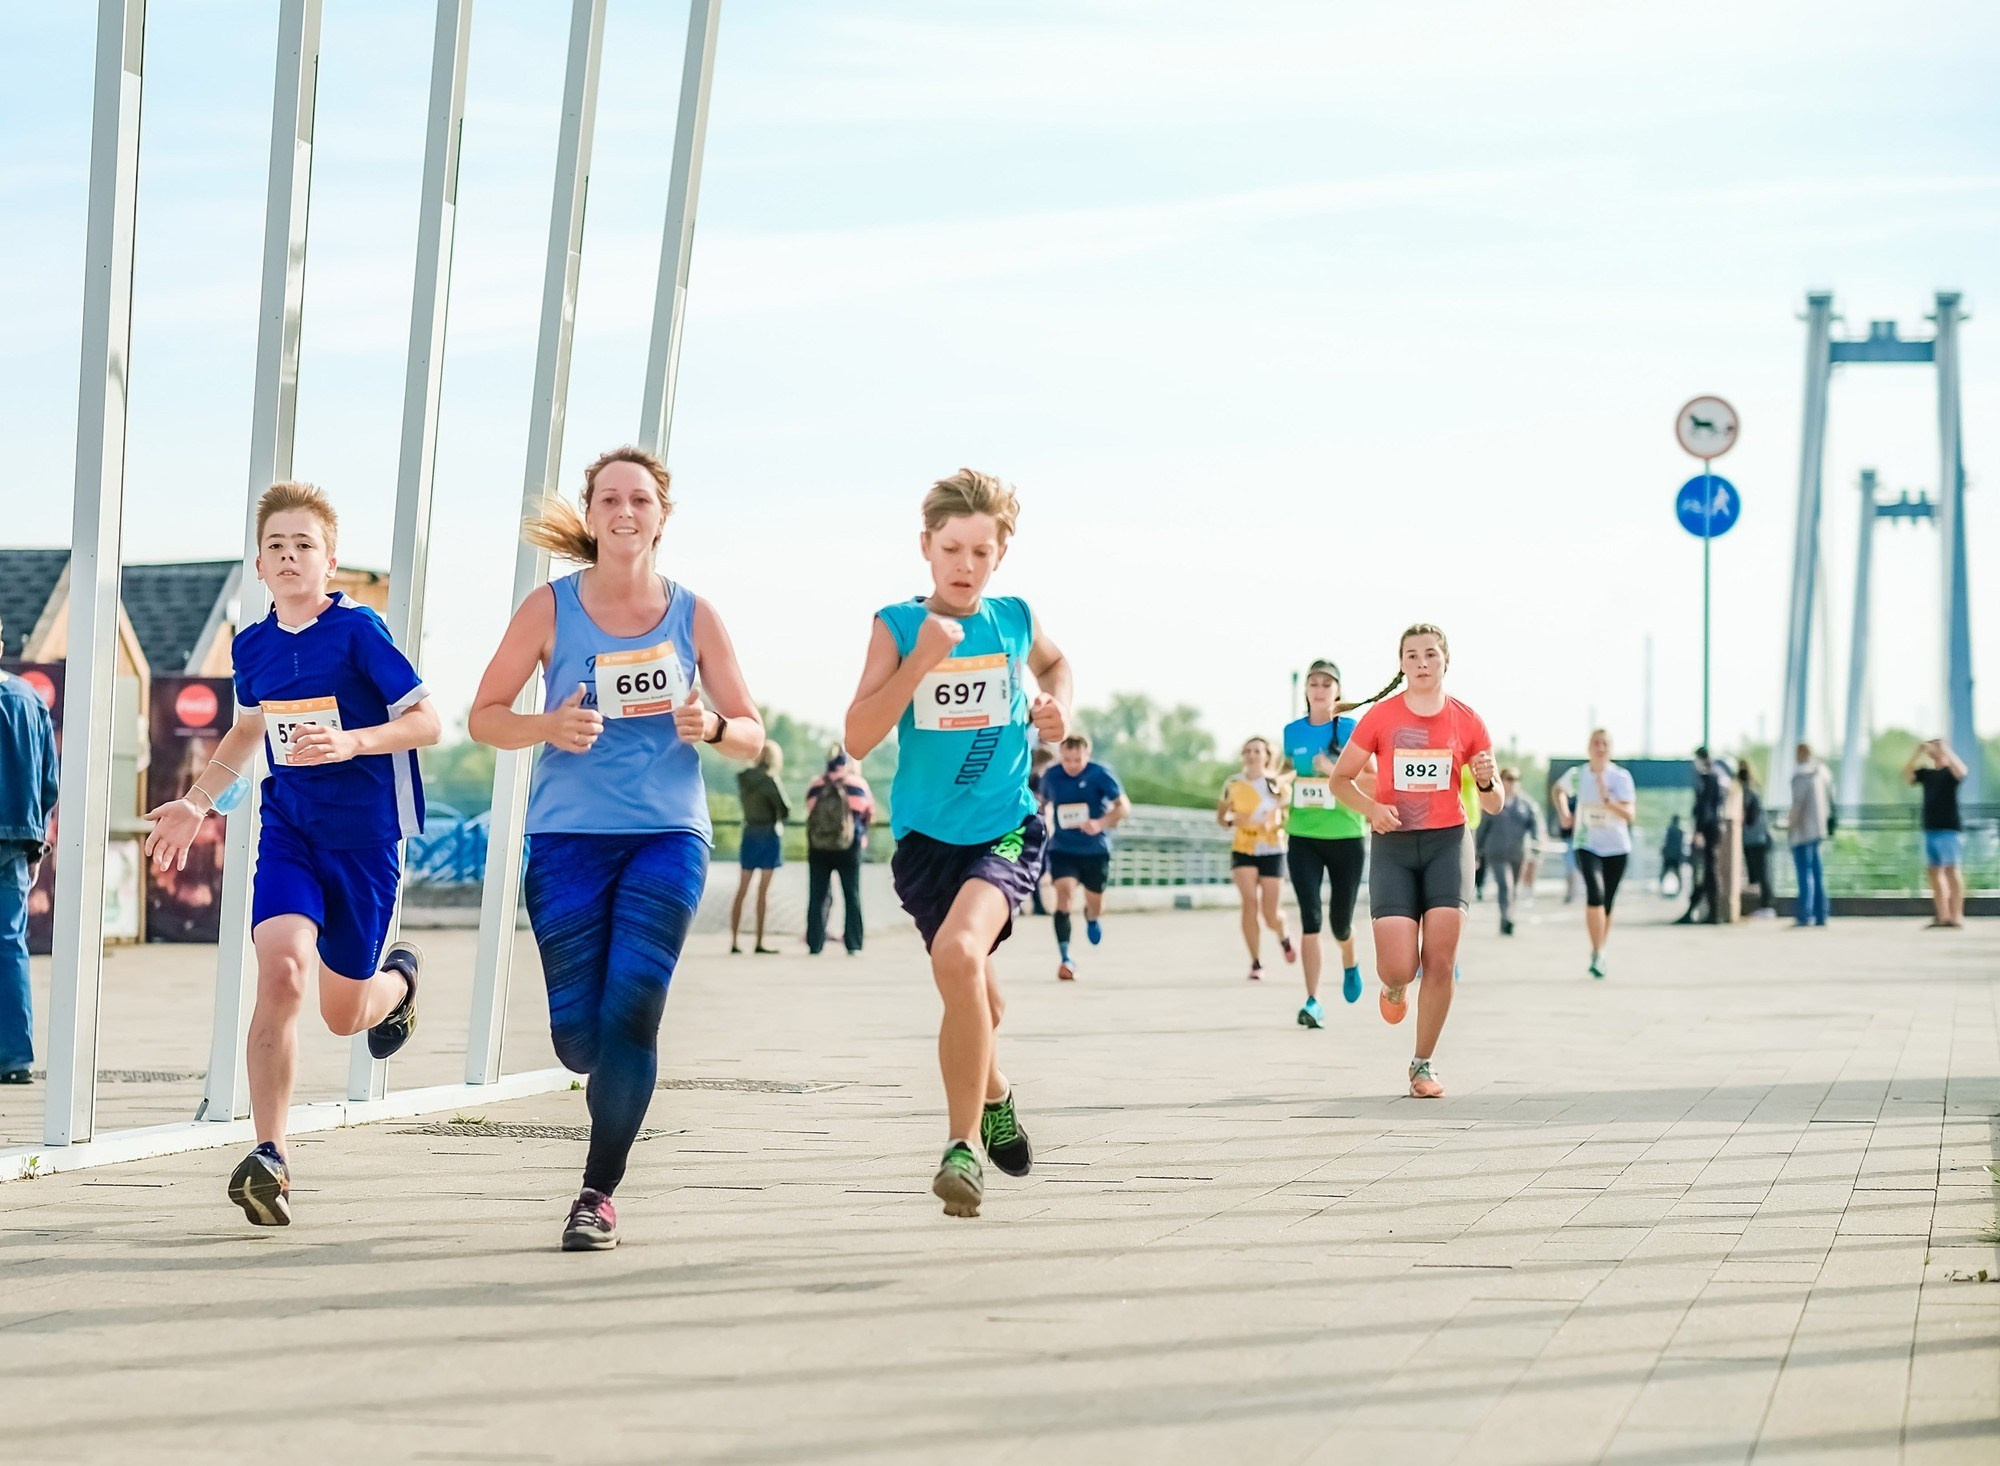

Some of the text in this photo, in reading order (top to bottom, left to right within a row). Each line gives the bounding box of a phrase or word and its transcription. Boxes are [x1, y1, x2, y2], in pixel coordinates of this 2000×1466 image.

[616, 669, 667, 695] 660
[935, 681, 987, 706] 697
[1404, 763, 1438, 778] 892
[1302, 787, 1323, 798] 691
